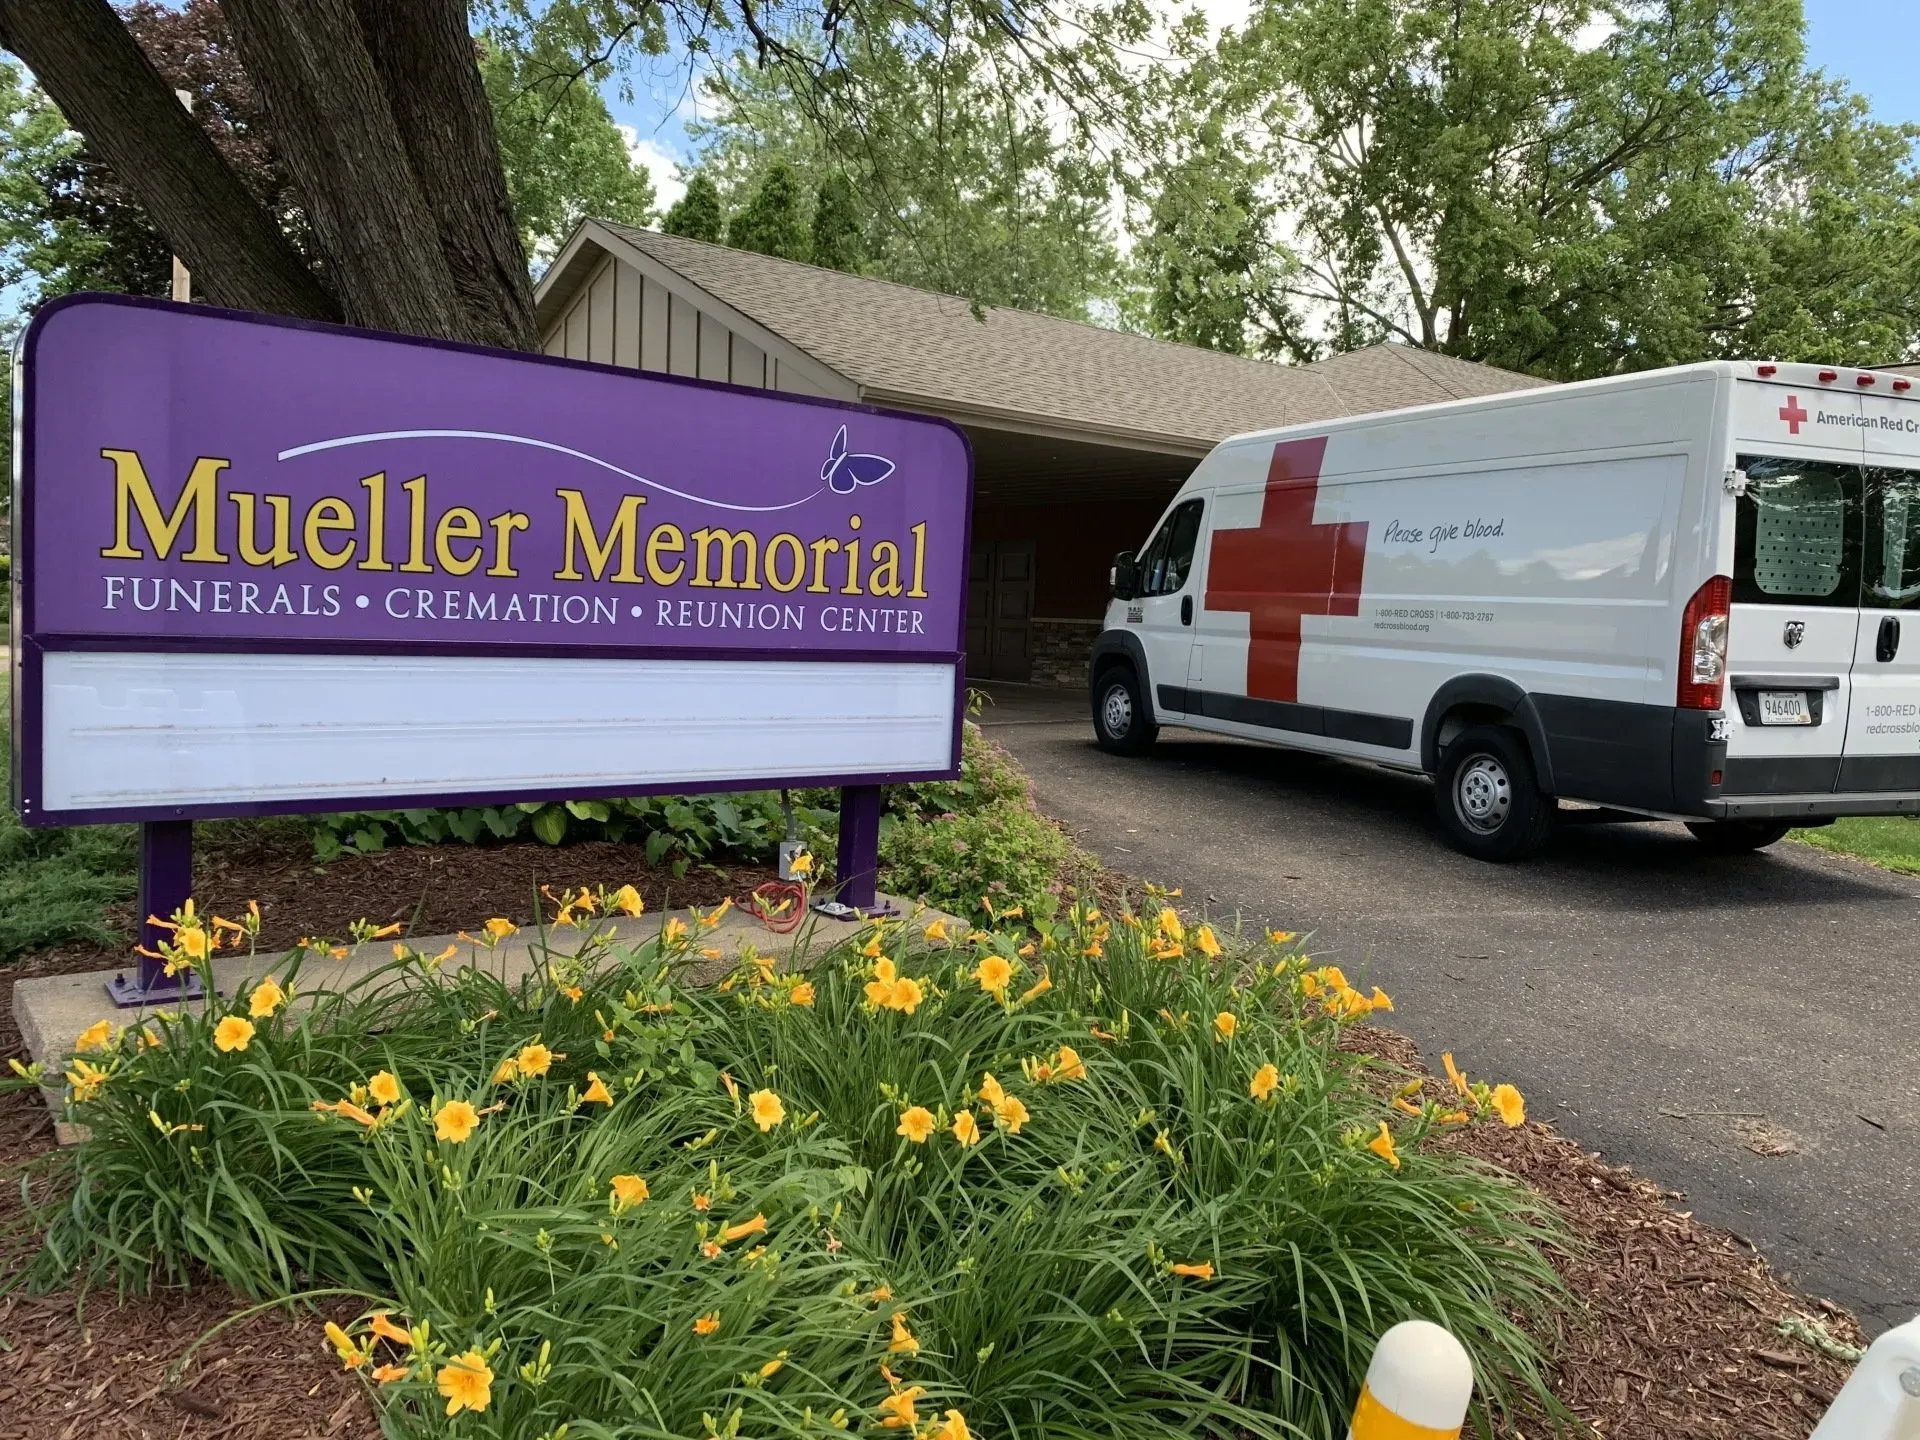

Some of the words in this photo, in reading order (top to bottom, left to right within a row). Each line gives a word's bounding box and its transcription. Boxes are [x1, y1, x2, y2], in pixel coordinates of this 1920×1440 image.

[1816, 411, 1878, 428] American
[1880, 416, 1903, 431] Red
[1906, 419, 1919, 433] Cr
[100, 448, 530, 577] Mueller
[553, 488, 929, 598] Memorial
[1384, 519, 1423, 544] Please
[1429, 522, 1459, 553] give
[1463, 518, 1504, 539] blood.
[102, 576, 341, 616] FUNERALS
[384, 587, 618, 625] CREMATION
[655, 599, 804, 630] REUNION
[820, 606, 925, 634] CENTER
[1375, 609, 1408, 618] 1-800-RED
[1410, 609, 1434, 619] CROSS
[1374, 621, 1430, 632] redcrossblood.org
[1765, 700, 1801, 715] 946400
[1866, 705, 1916, 716] 1-800-RED
